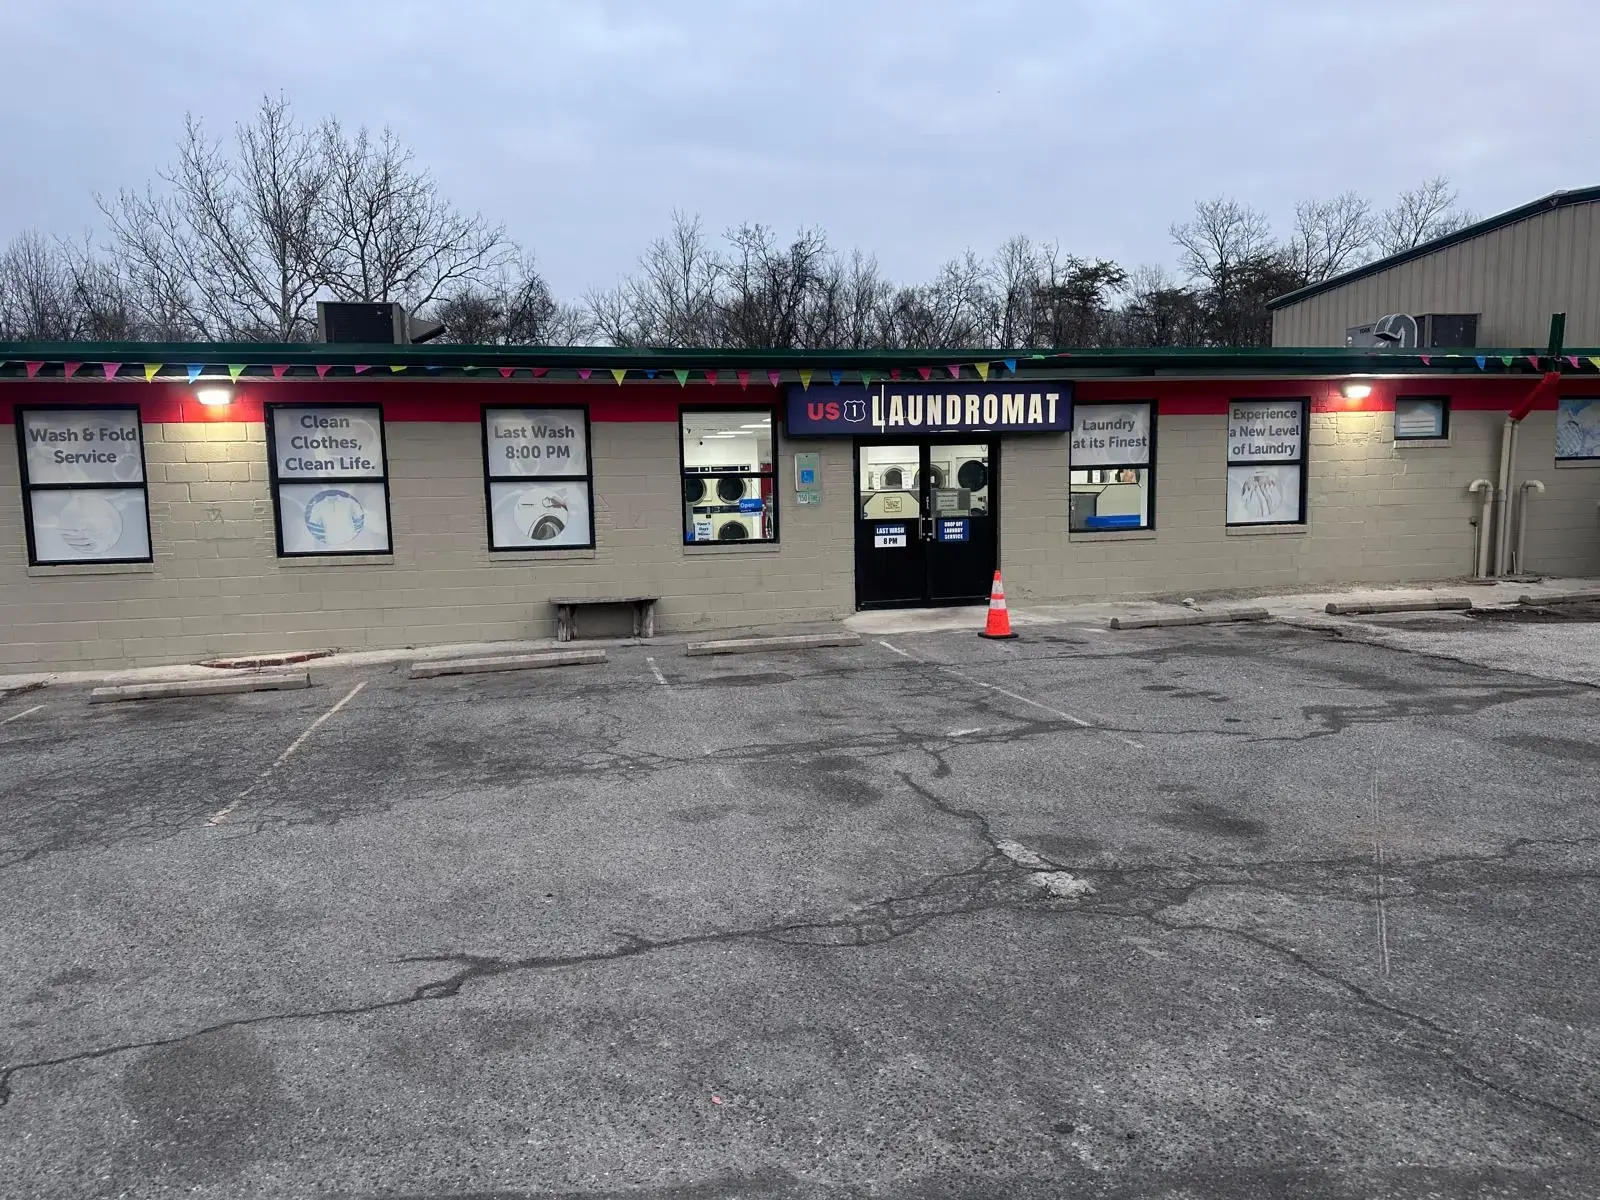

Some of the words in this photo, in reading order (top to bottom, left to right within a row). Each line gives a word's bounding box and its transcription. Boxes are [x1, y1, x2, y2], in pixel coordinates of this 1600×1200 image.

[807, 402, 840, 421] US
[851, 404, 858, 417] 1
[871, 393, 1059, 426] LAUNDROMAT
[1233, 408, 1297, 422] Experience
[300, 414, 350, 429] Clean
[1082, 419, 1135, 432] Laundry
[29, 427, 79, 443] Wash
[82, 427, 96, 442] &
[99, 426, 137, 442] Fold
[494, 425, 527, 439] Last
[530, 425, 575, 439] Wash
[1229, 427, 1236, 437] a
[1239, 426, 1266, 437] New
[1268, 424, 1300, 436] Level
[290, 435, 363, 451] Clothes,
[1073, 438, 1087, 449] at
[1089, 437, 1105, 448] its
[1108, 435, 1147, 448] Finest
[1232, 443, 1245, 455] of
[1248, 442, 1295, 456] Laundry
[54, 449, 117, 464] Service
[505, 445, 541, 459] 8:00
[546, 445, 571, 458] PM
[285, 457, 335, 471] Clean
[339, 456, 375, 471] Life.
[889, 526, 905, 534] WASH
